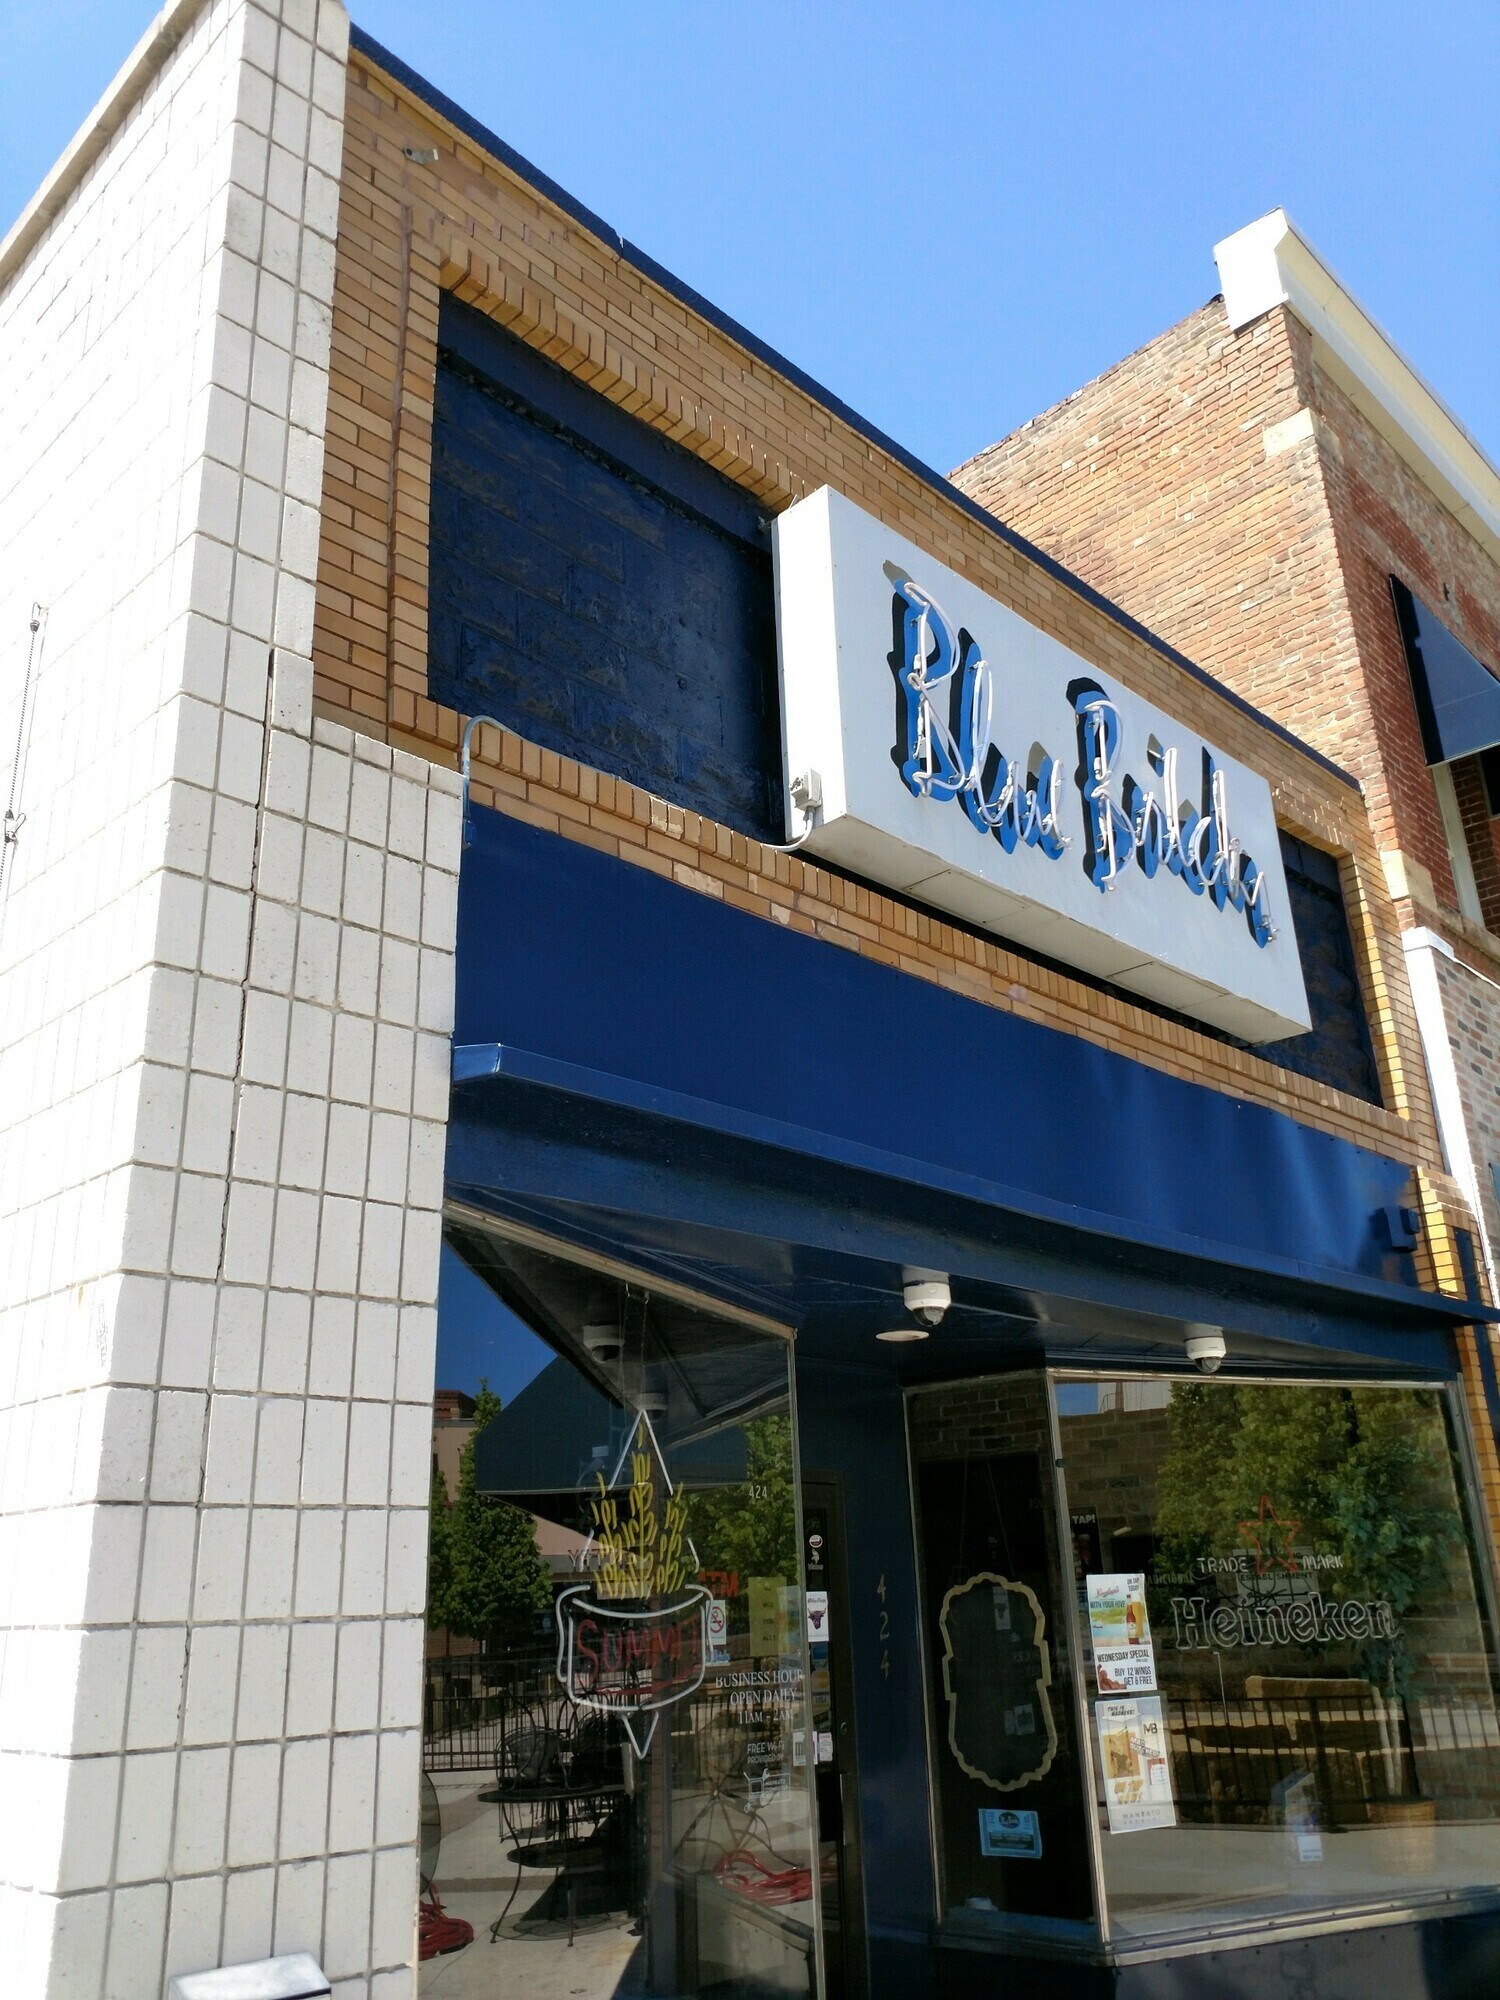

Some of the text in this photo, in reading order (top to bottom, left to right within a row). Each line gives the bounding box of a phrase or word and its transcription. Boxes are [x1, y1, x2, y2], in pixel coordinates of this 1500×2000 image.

[896, 578, 1280, 949] Blue Bricks
[749, 1485, 767, 1499] 424
[1072, 1514, 1096, 1524] TAP!
[1197, 1555, 1344, 1573] TRADE MARK
[1171, 1592, 1399, 1650] Heineken
[576, 1614, 702, 1688] SUMMIT
[1097, 1649, 1150, 1663] WEDNESDAY SPECIAL
[1114, 1666, 1151, 1676] BUY 12 WINGS
[715, 1669, 806, 1688] BUSINESS HOUR
[1124, 1677, 1134, 1686] GET
[1140, 1675, 1153, 1685] FREE
[730, 1687, 797, 1706] OPEN DAILY
[738, 1711, 763, 1725] 11AM
[774, 1708, 794, 1722] 2AM
[1143, 1723, 1158, 1734] MB
[747, 1742, 766, 1754] FREE
[747, 1754, 776, 1764] PROVIDED
